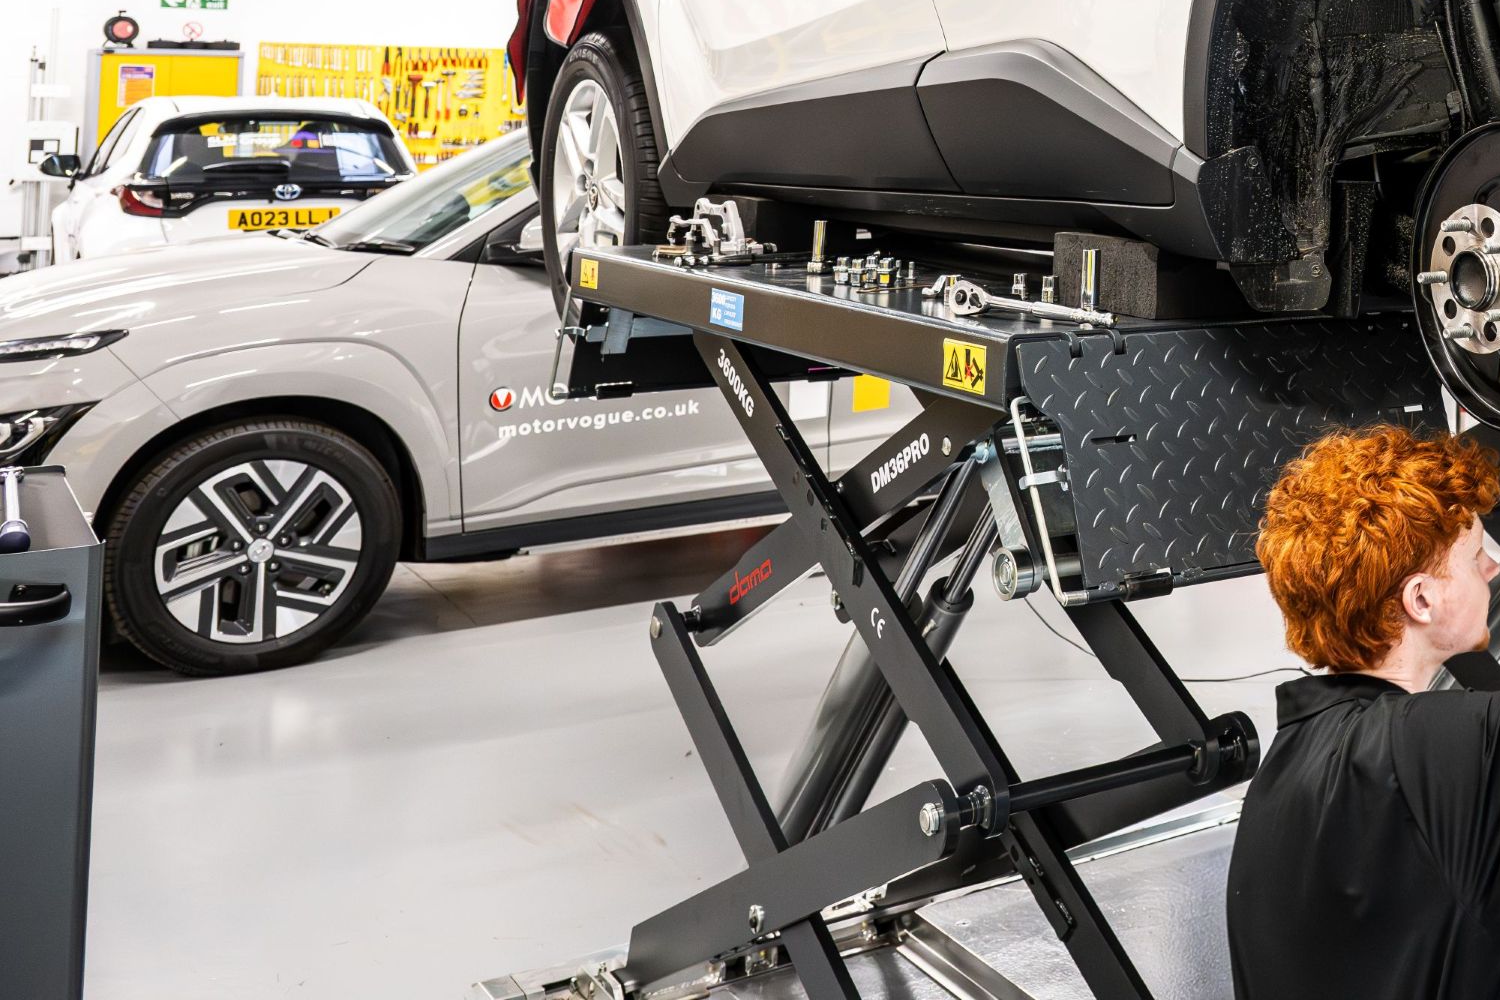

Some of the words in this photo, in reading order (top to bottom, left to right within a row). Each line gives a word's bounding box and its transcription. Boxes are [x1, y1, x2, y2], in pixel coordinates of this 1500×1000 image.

[238, 211, 289, 227] AO23
[717, 348, 755, 418] 3600KG
[498, 399, 700, 439] motorvogue.co.uk
[870, 432, 930, 494] DM36PRO
